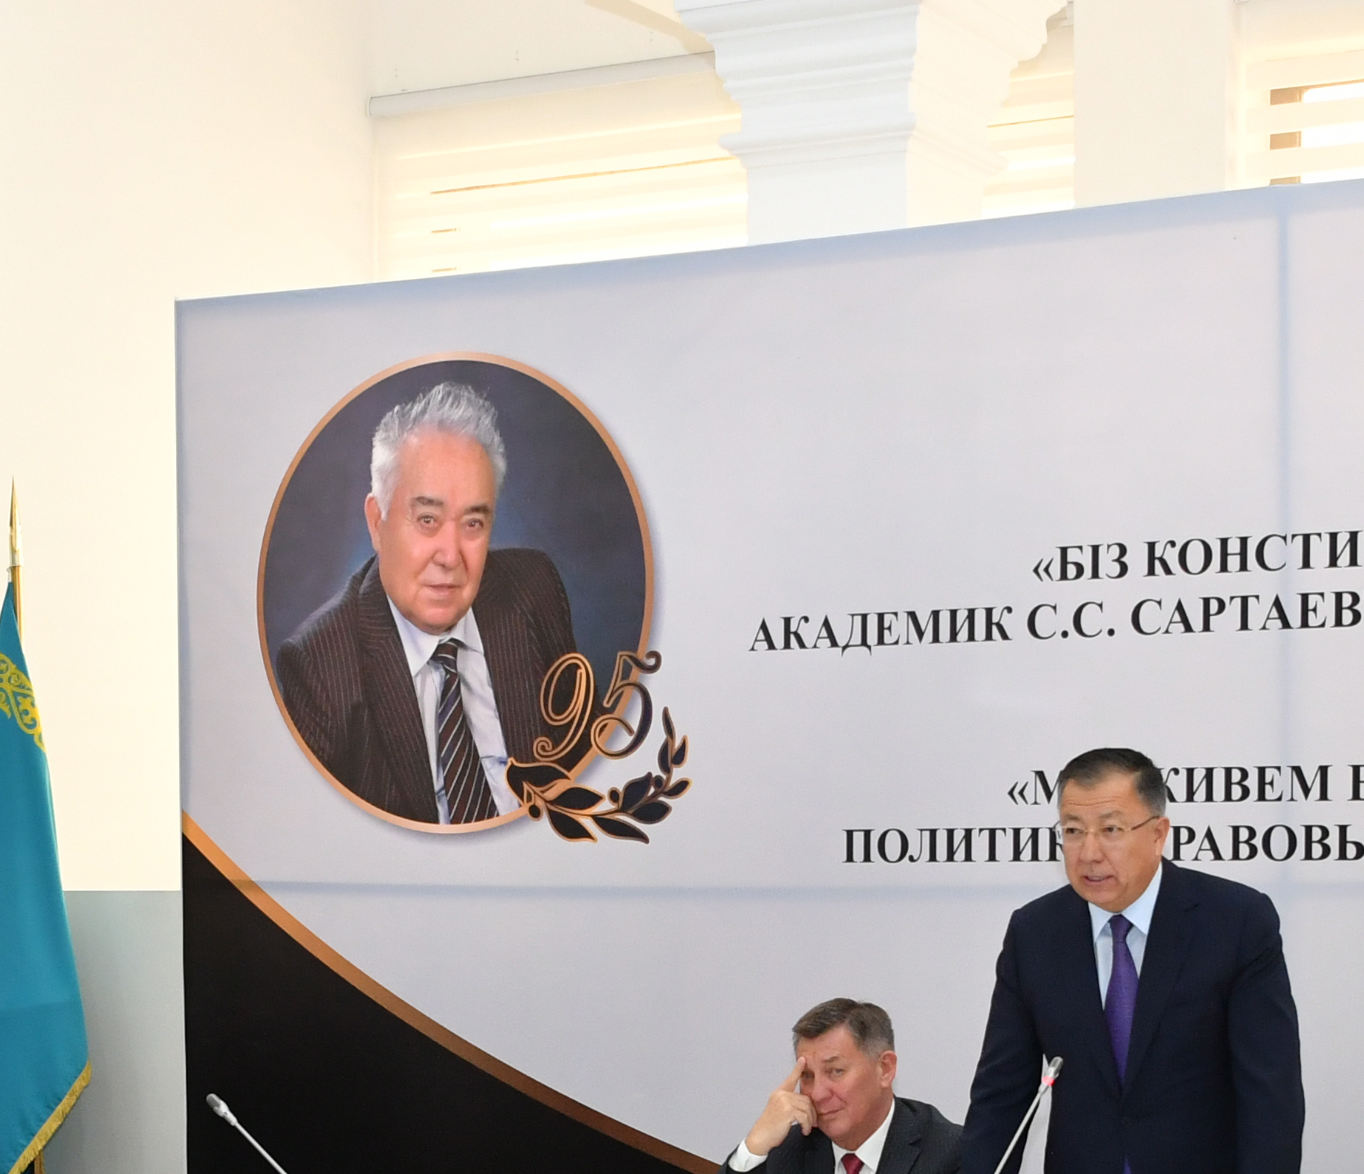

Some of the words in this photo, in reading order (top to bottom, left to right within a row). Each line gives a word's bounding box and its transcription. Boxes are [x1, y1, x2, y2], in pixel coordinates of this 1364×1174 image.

[1032, 542, 1129, 582] «БІЗ
[748, 605, 1013, 657] АКАДЕМИК
[1026, 601, 1116, 641] С.С.
[533, 650, 663, 762] 95
[1007, 769, 1064, 806] «М
